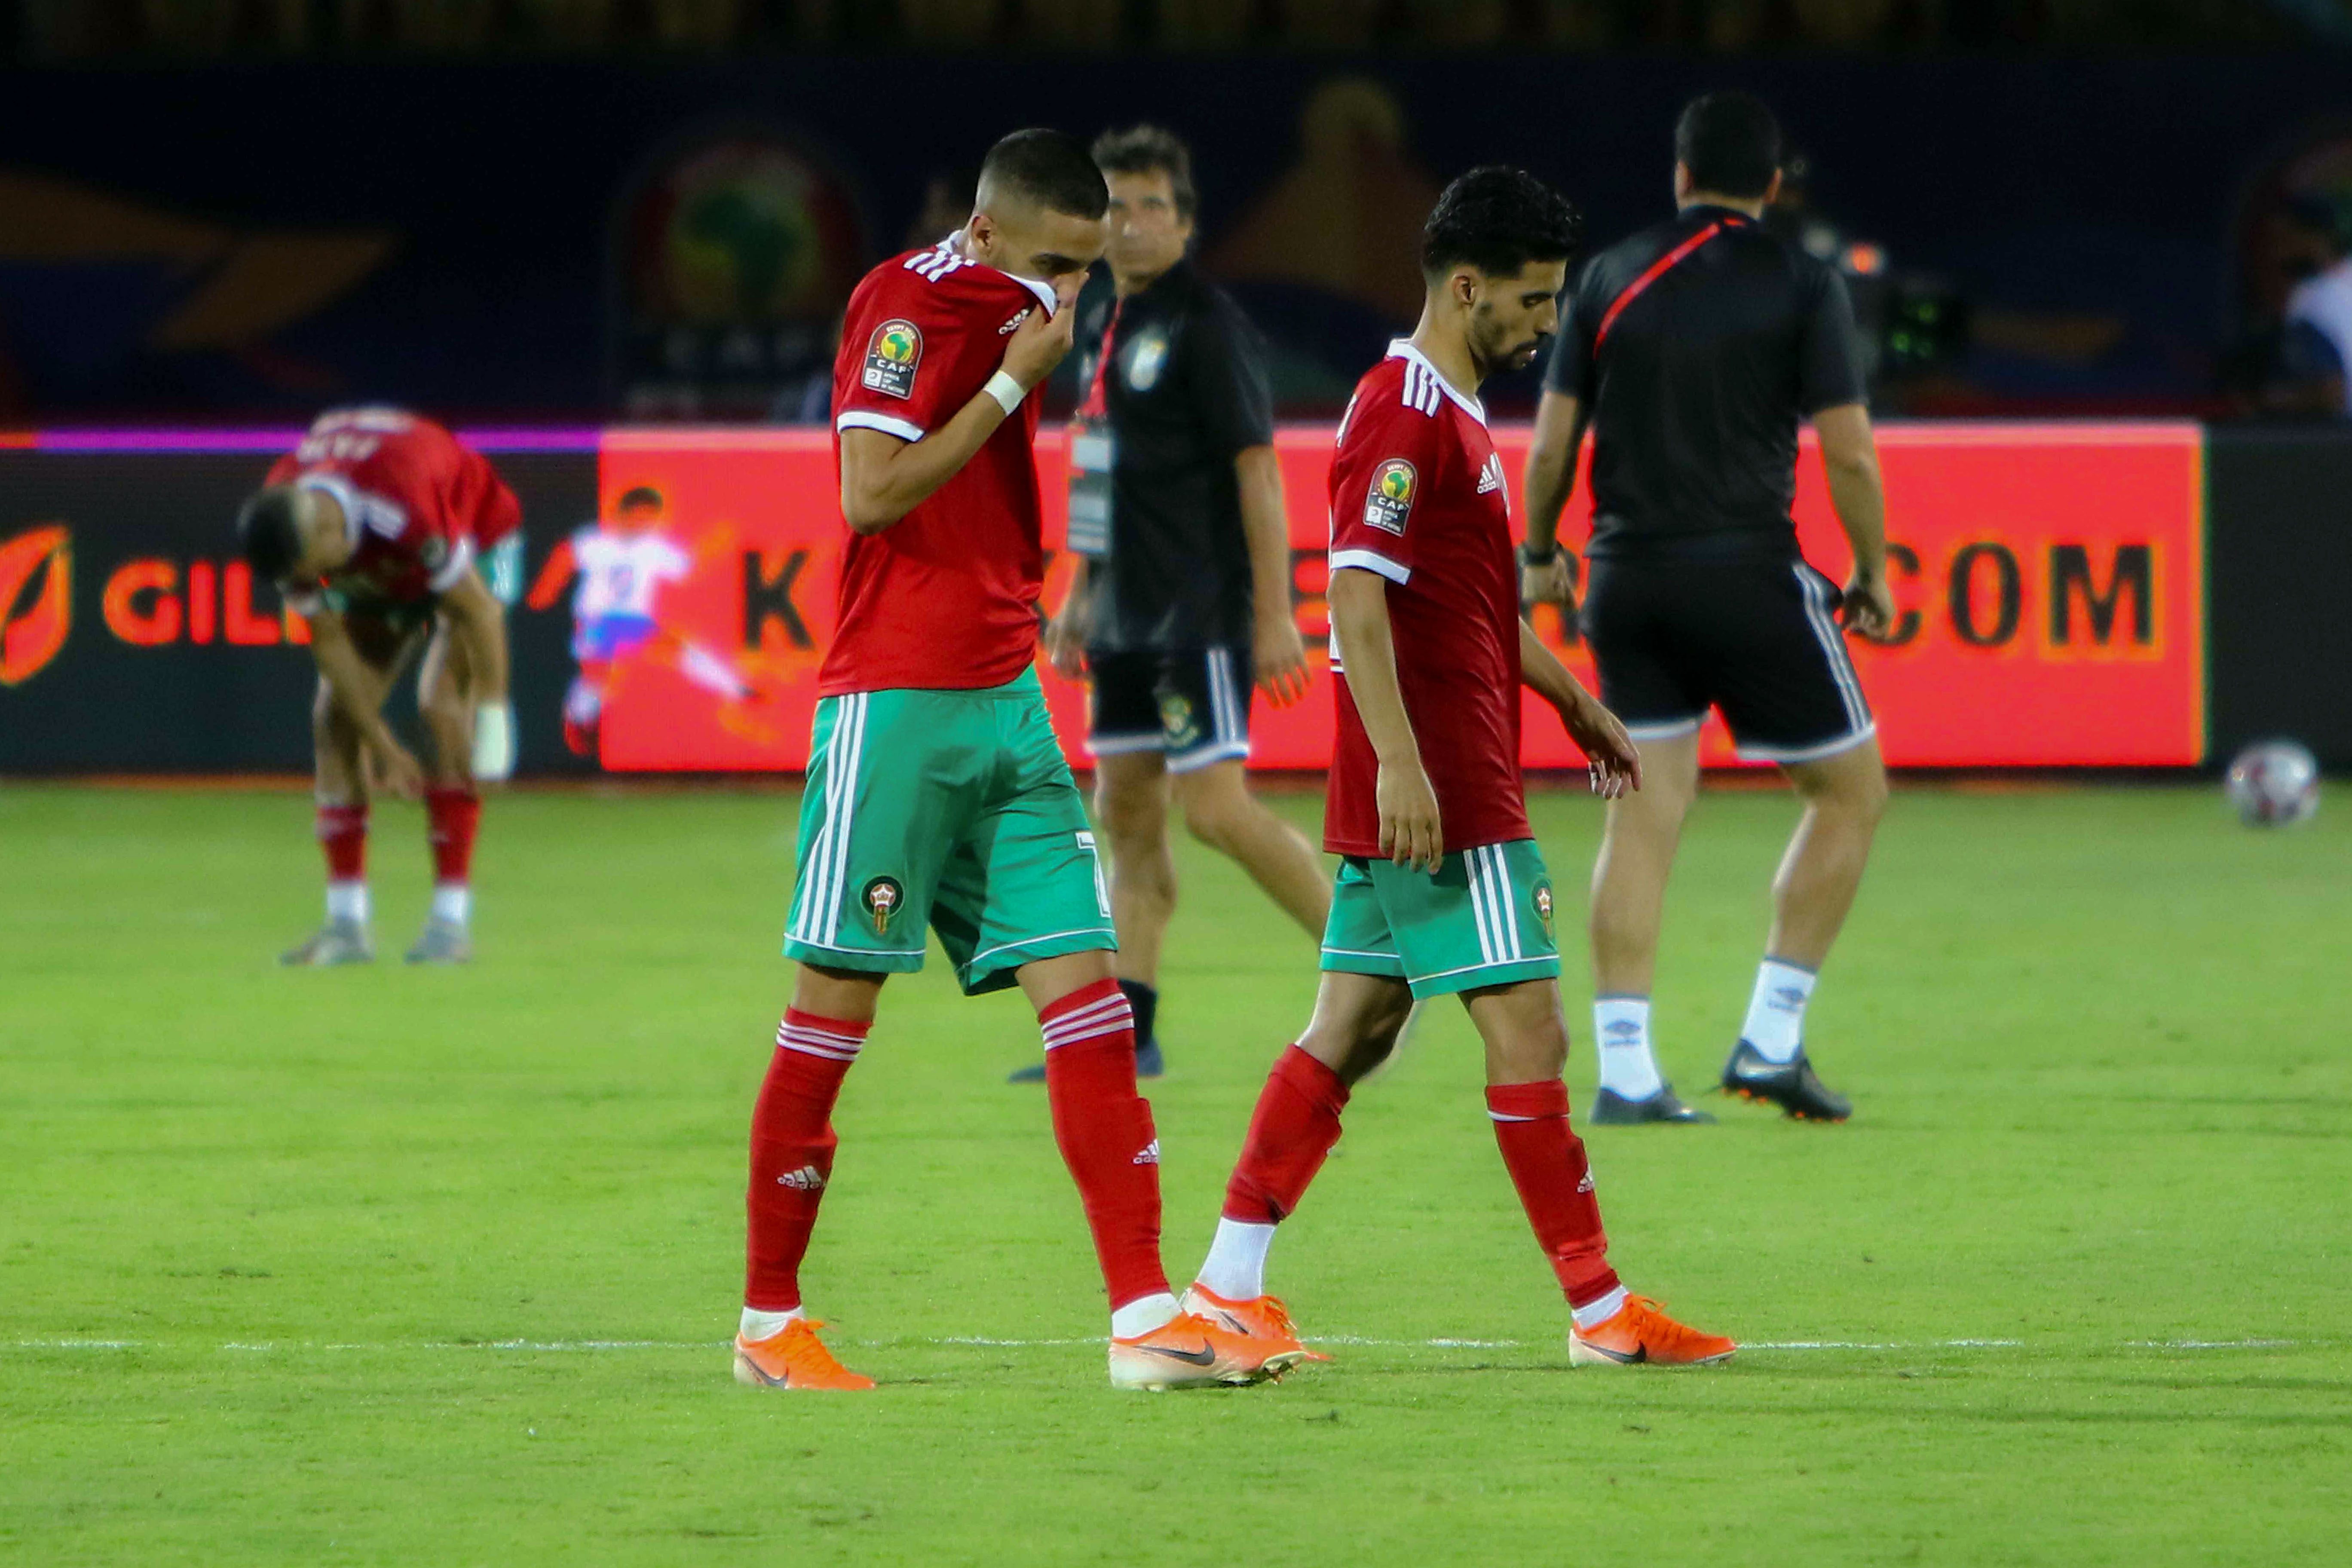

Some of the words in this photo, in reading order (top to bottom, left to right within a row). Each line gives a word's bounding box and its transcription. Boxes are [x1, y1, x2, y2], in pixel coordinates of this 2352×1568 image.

[876, 359, 907, 374] CAF
[1377, 497, 1404, 511] CAF
[102, 556, 313, 646] GIL
